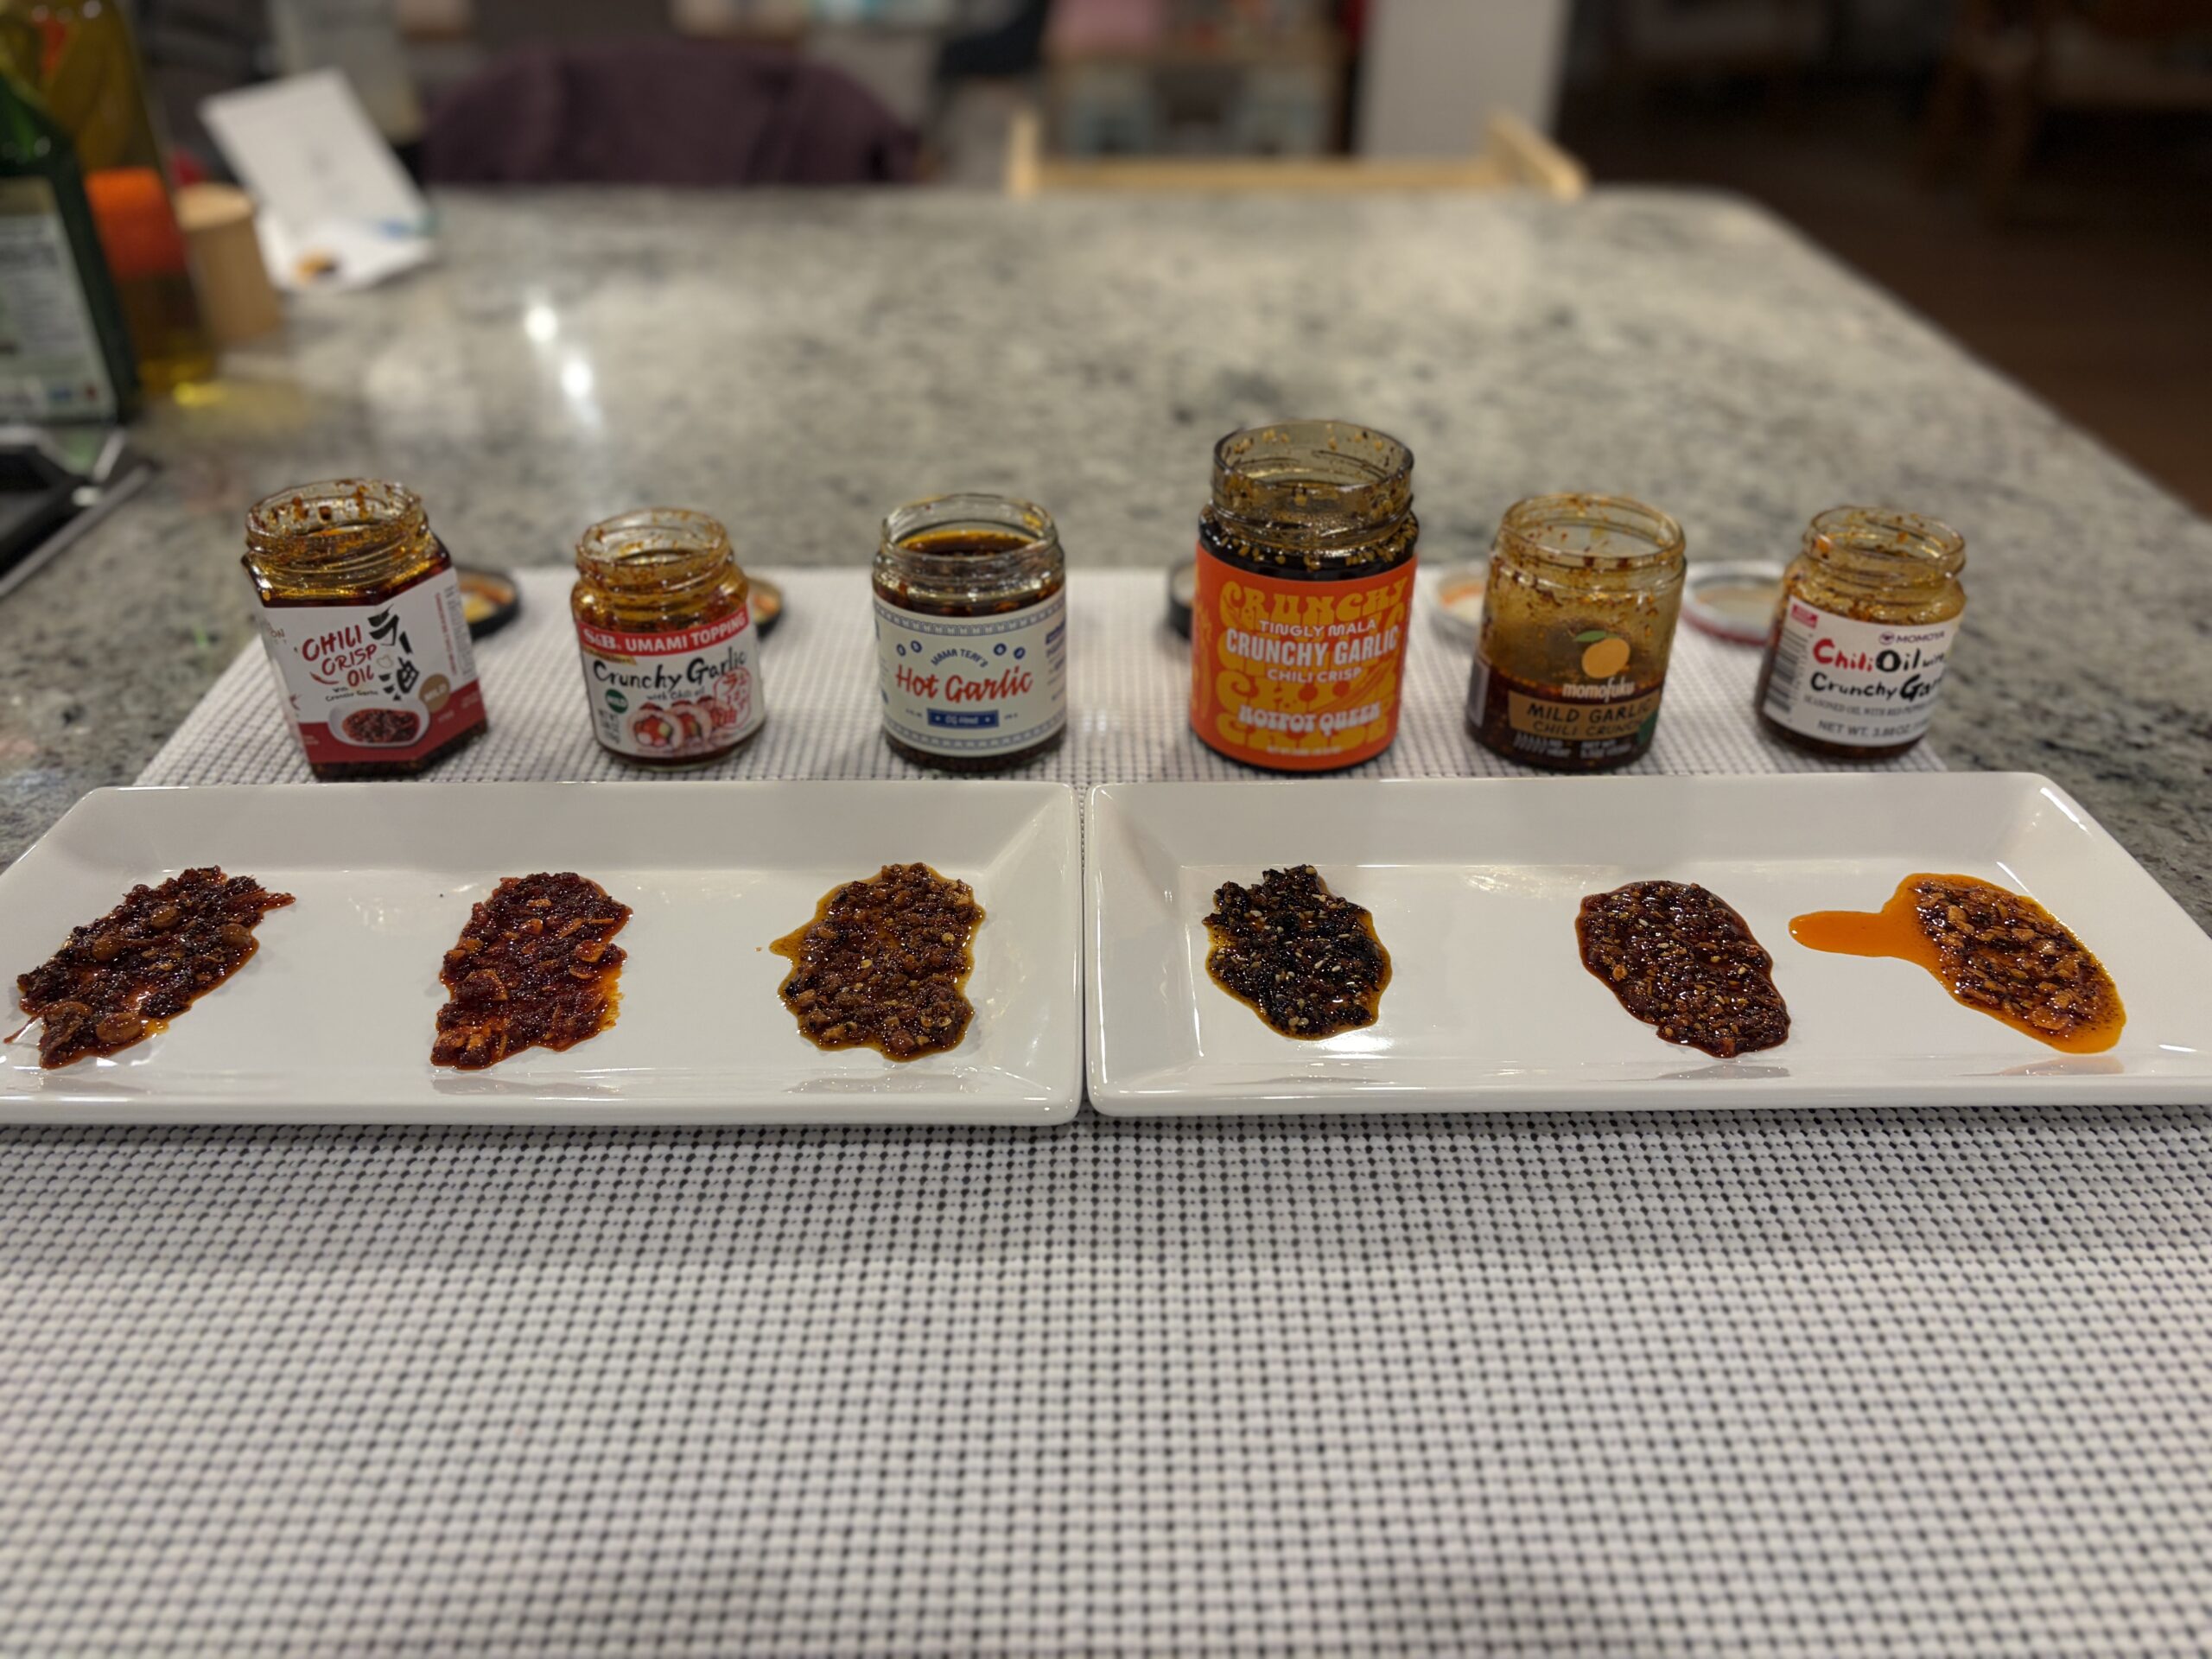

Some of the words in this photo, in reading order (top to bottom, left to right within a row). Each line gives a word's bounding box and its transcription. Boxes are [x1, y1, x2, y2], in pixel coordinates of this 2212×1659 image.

[626, 636, 688, 652] UMAMI
[690, 613, 747, 645] TOPPING
[1259, 620, 1325, 638] TINGLY
[1328, 619, 1376, 638] MALA
[1896, 631, 1945, 644] MOMOYA
[302, 625, 361, 661] CHILI
[1226, 628, 1330, 667] CRUNCHY
[1334, 626, 1400, 665] GARLIC
[1813, 639, 1874, 672] Chili
[1876, 648, 1921, 672] Oil
[321, 644, 377, 676] CRISP
[593, 660, 683, 691] Crunchy
[686, 647, 747, 685] Garlic
[931, 648, 958, 666] MAMA
[347, 665, 374, 687] OIL
[895, 664, 939, 700] Hot
[945, 665, 1033, 703] Garlic
[1267, 668, 1313, 683] CHILI
[1317, 666, 1363, 683] CRISP
[1811, 672, 1898, 700] Crunchy
[1561, 676, 1636, 702] momofuku
[1238, 703, 1317, 734] HOTPOT
[1319, 701, 1382, 736] QUEEN
[1527, 702, 1580, 724] MILD
[1588, 697, 1653, 724] GARLIC
[1533, 721, 1578, 736] CHILI
[1818, 720, 1844, 734] NET
